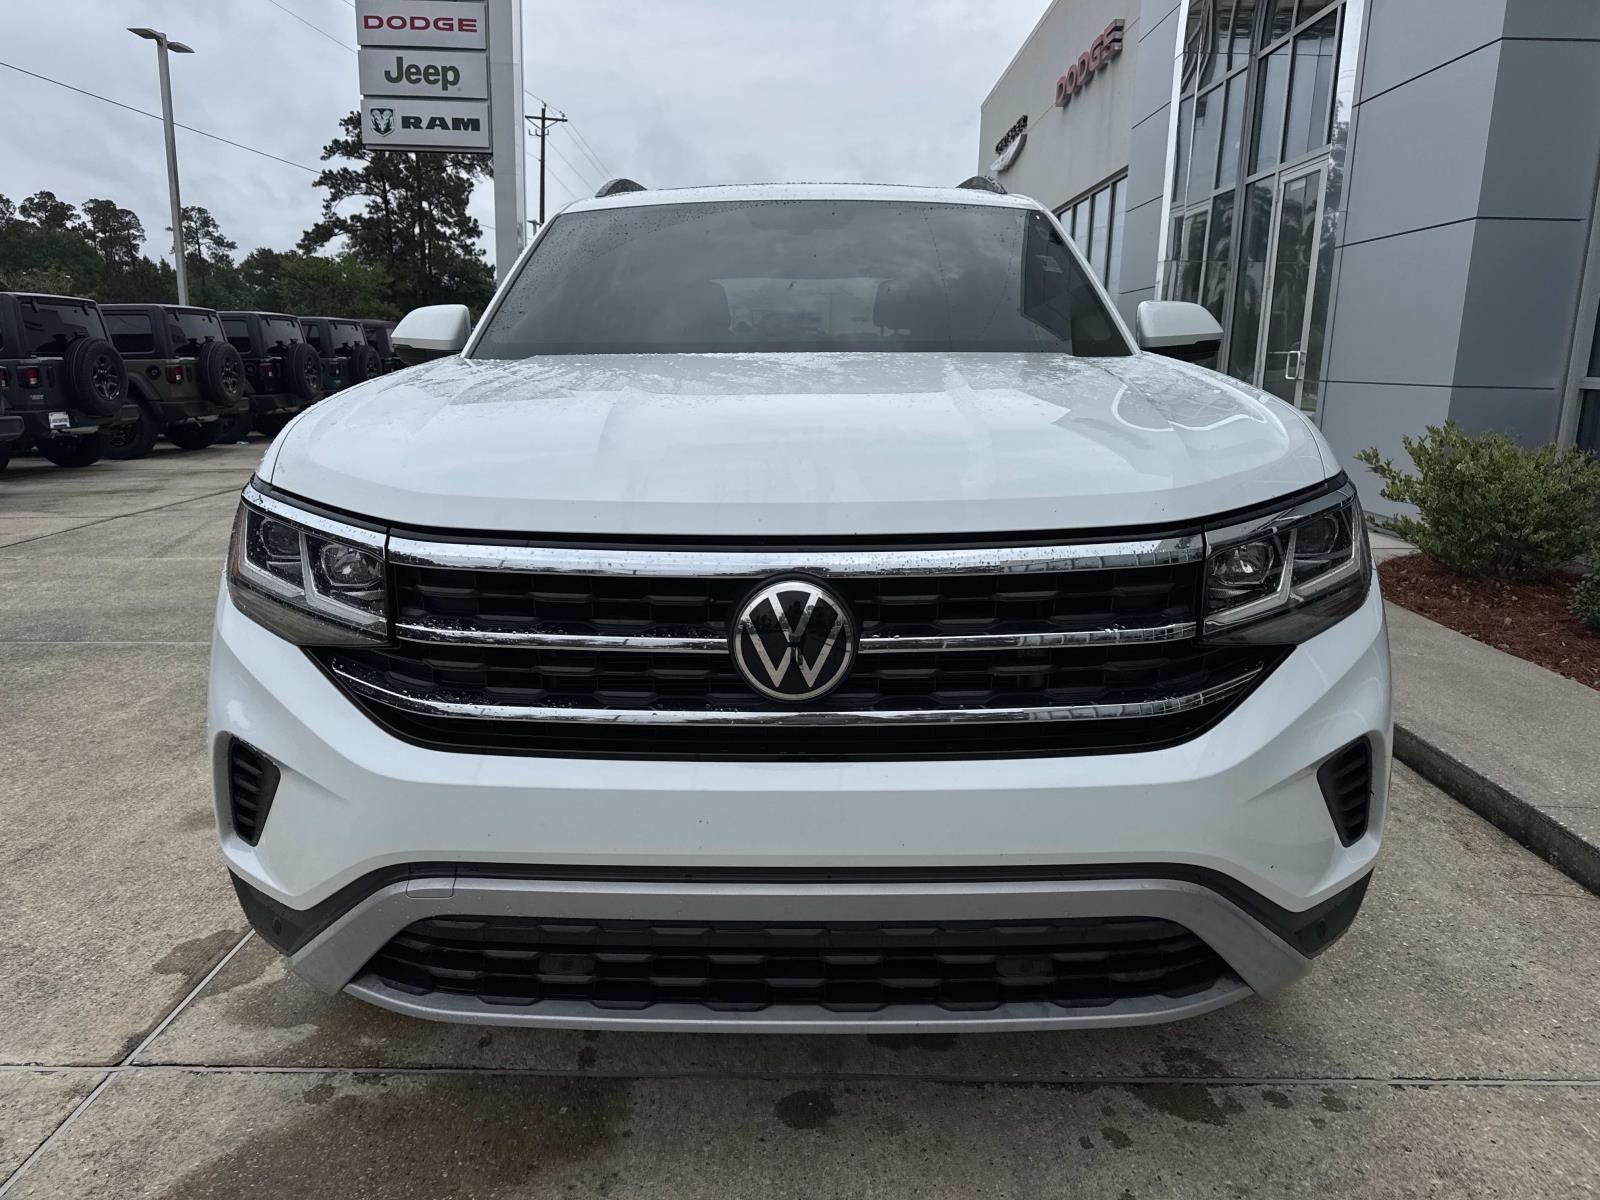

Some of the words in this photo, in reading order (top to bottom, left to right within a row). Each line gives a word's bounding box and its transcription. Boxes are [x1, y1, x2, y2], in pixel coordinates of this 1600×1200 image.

[363, 15, 478, 32] DODGE
[384, 56, 461, 91] Jeep
[1055, 19, 1124, 107] DODGE
[401, 115, 481, 131] RAM
[738, 582, 848, 694] VW
